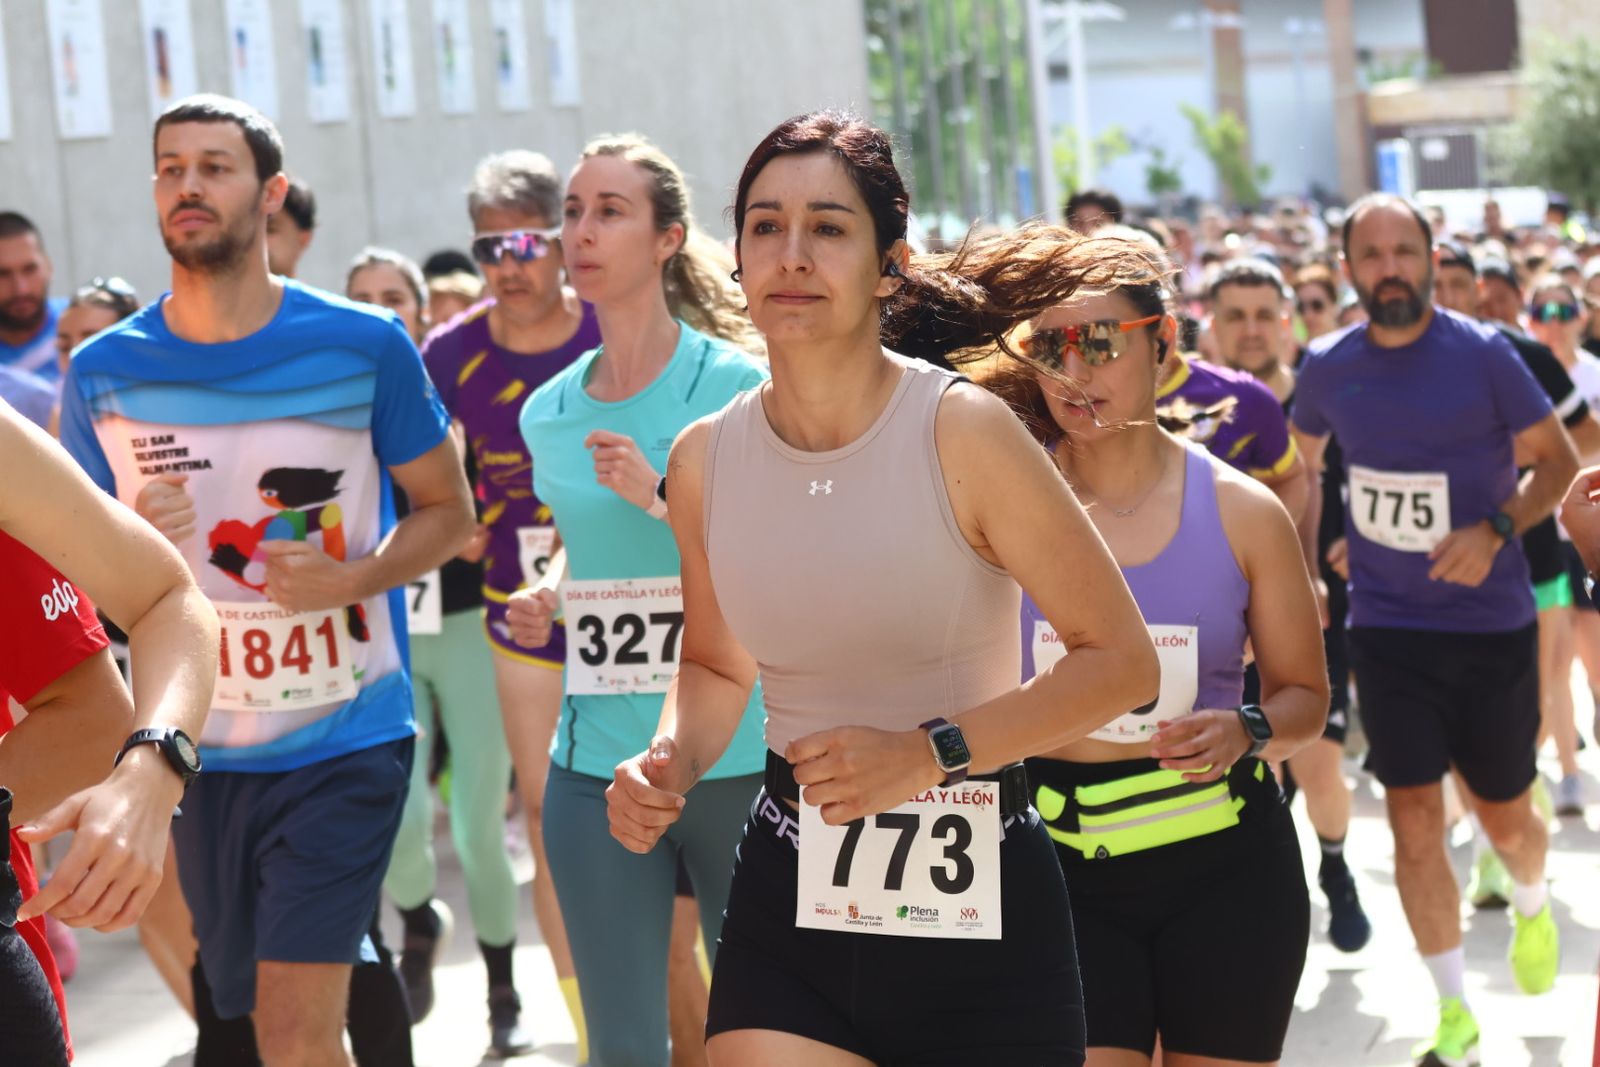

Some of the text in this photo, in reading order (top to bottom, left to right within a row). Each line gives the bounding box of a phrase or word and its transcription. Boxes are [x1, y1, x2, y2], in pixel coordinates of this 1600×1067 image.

[150, 434, 175, 446] SAN
[1361, 486, 1434, 530] 775
[41, 578, 79, 621] edp
[585, 591, 598, 600] DE
[600, 589, 648, 600] CASTILLA
[648, 588, 657, 598] Y
[658, 585, 682, 597] LEÓ
[225, 610, 239, 620] DE
[577, 611, 684, 667] 327
[1154, 634, 1189, 648] LEÓN
[220, 615, 340, 680] 1841
[938, 791, 949, 804] Y
[952, 788, 994, 806] LEÓN
[831, 812, 975, 895] 773
[909, 905, 939, 917] Plena
[844, 918, 864, 926] Castilla
[909, 915, 939, 923] inclusión
